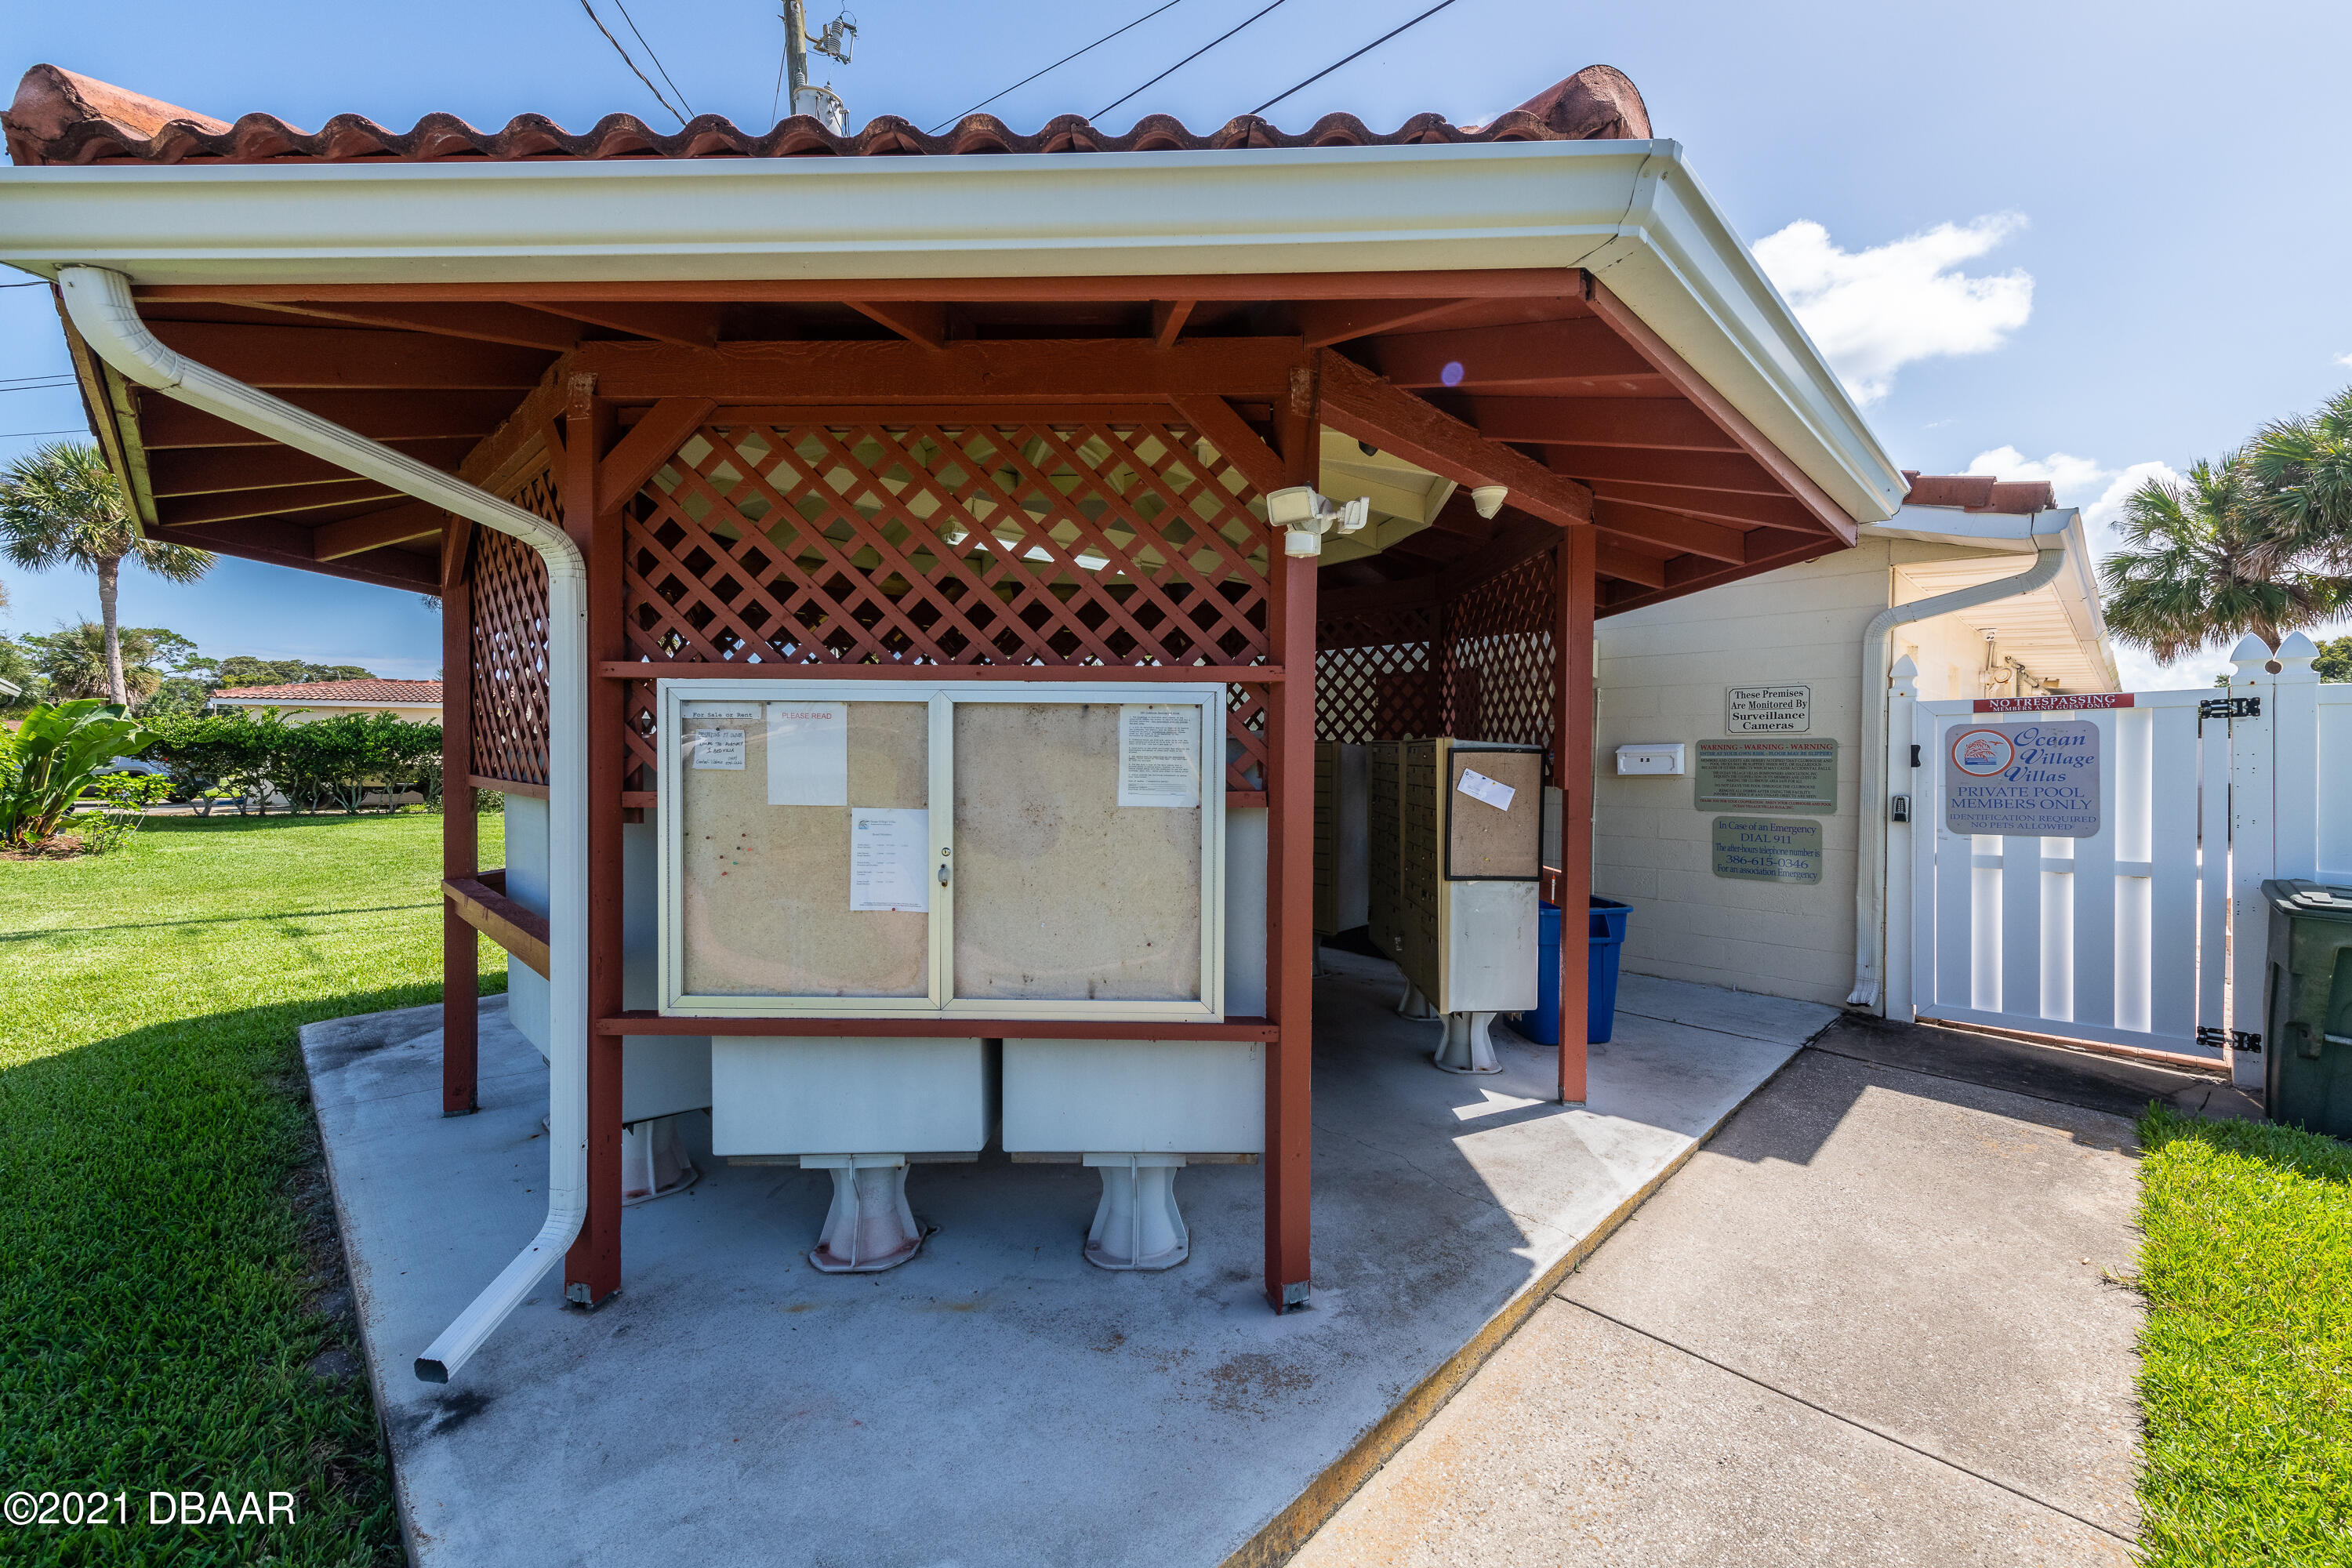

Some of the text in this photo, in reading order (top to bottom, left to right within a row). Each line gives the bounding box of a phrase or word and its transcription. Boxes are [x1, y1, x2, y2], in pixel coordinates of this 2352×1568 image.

[1748, 700, 1793, 710] Monitored
[1795, 699, 1808, 709] By
[2014, 695, 2116, 706] TRESPASSING
[1733, 712, 1805, 720] Surveillance
[1743, 721, 1794, 730] Cameras
[2014, 728, 2086, 747] Ocean
[2020, 749, 2094, 768] Village
[2004, 766, 2067, 782] Villas
[1957, 786, 2085, 797] PRIVATE POOL
[1951, 798, 2092, 810] MEMBERS ONLY
[1719, 821, 1727, 829] In
[1728, 822, 1747, 830] Case
[1748, 822, 1757, 831] of
[1770, 823, 1817, 836] Emergency
[1740, 833, 1791, 844] DIAL 911
[1716, 843, 1820, 858] The after-hours telephone number is
[1726, 855, 1809, 869] 386-615-0346
[1718, 864, 1729, 873] For
[1739, 867, 1776, 877] association
[1777, 869, 1817, 882] Emergency
